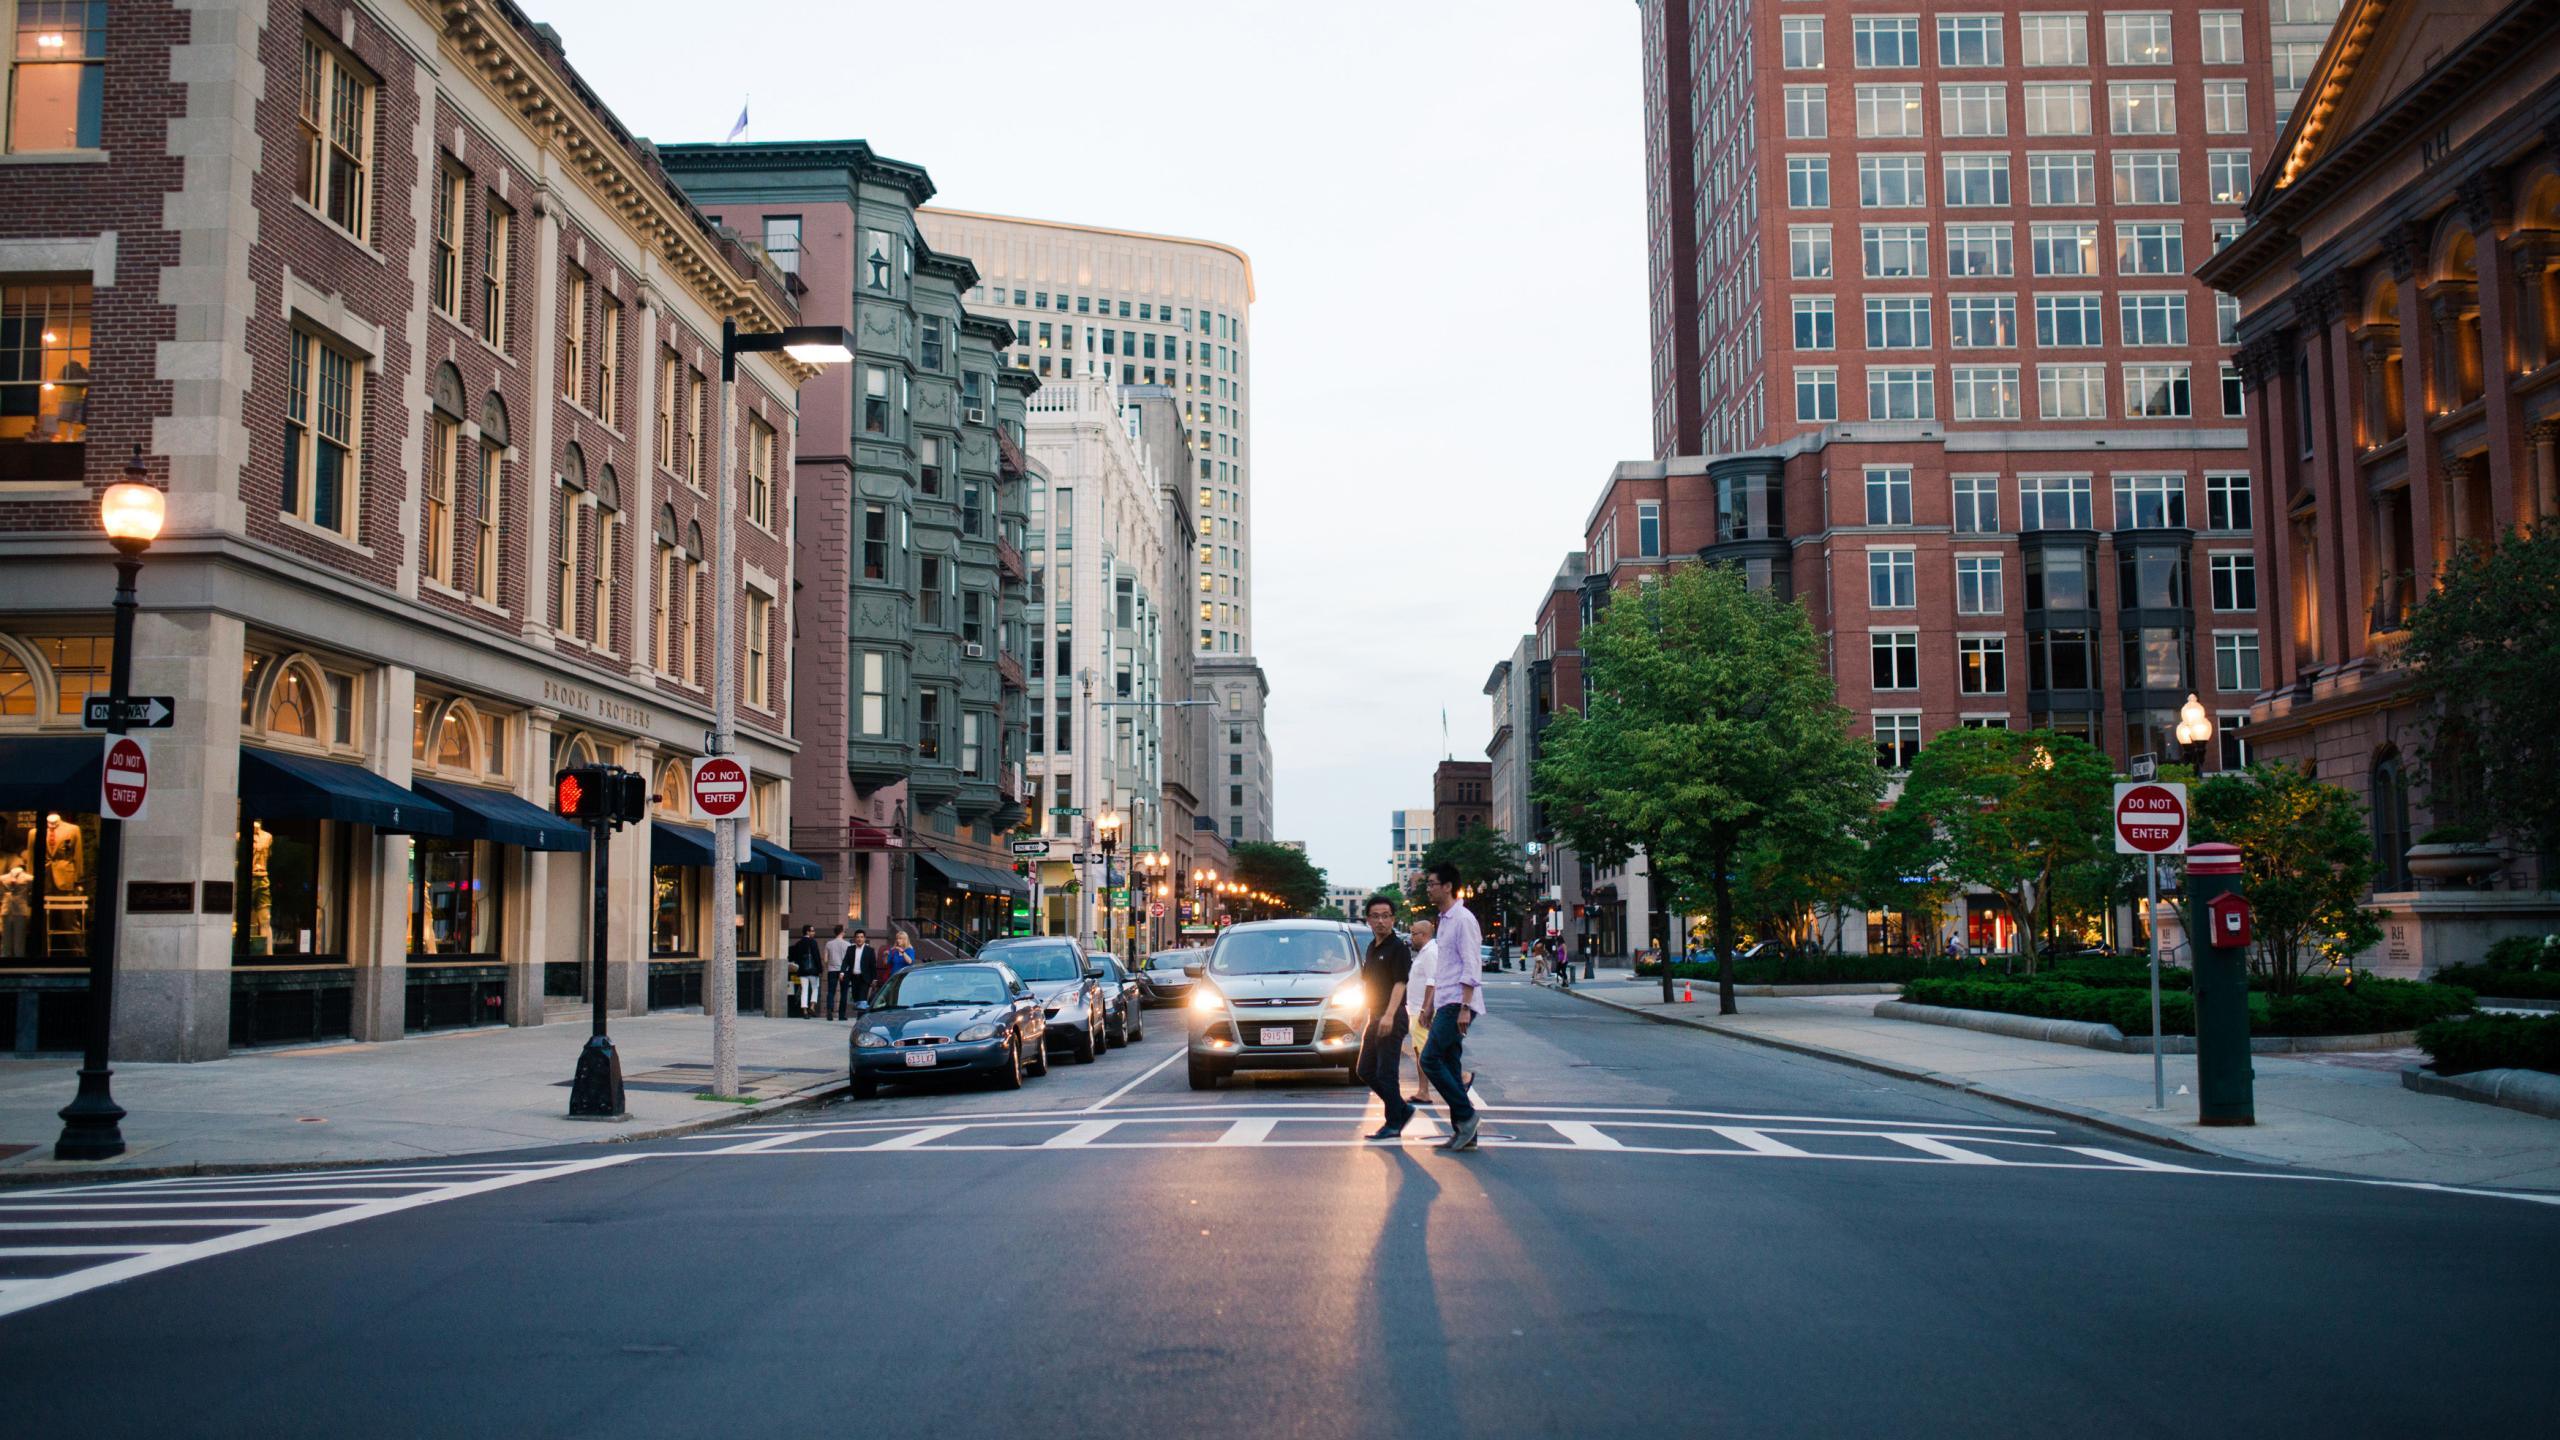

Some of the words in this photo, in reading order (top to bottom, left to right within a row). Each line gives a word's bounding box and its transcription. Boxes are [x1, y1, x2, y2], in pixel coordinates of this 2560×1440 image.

[544, 680, 589, 711] BROOKS
[598, 699, 650, 729] BROTHERS
[113, 753, 124, 766] DO
[126, 756, 141, 768] NOT
[701, 771, 716, 781] DO
[720, 771, 740, 781] NOT
[112, 789, 137, 803] ENTER
[704, 794, 736, 803] ENTER
[2128, 798, 2145, 809] DO
[2149, 799, 2172, 810] NOT
[2132, 828, 2169, 839] ENTER
[2391, 926, 2404, 940] RH
